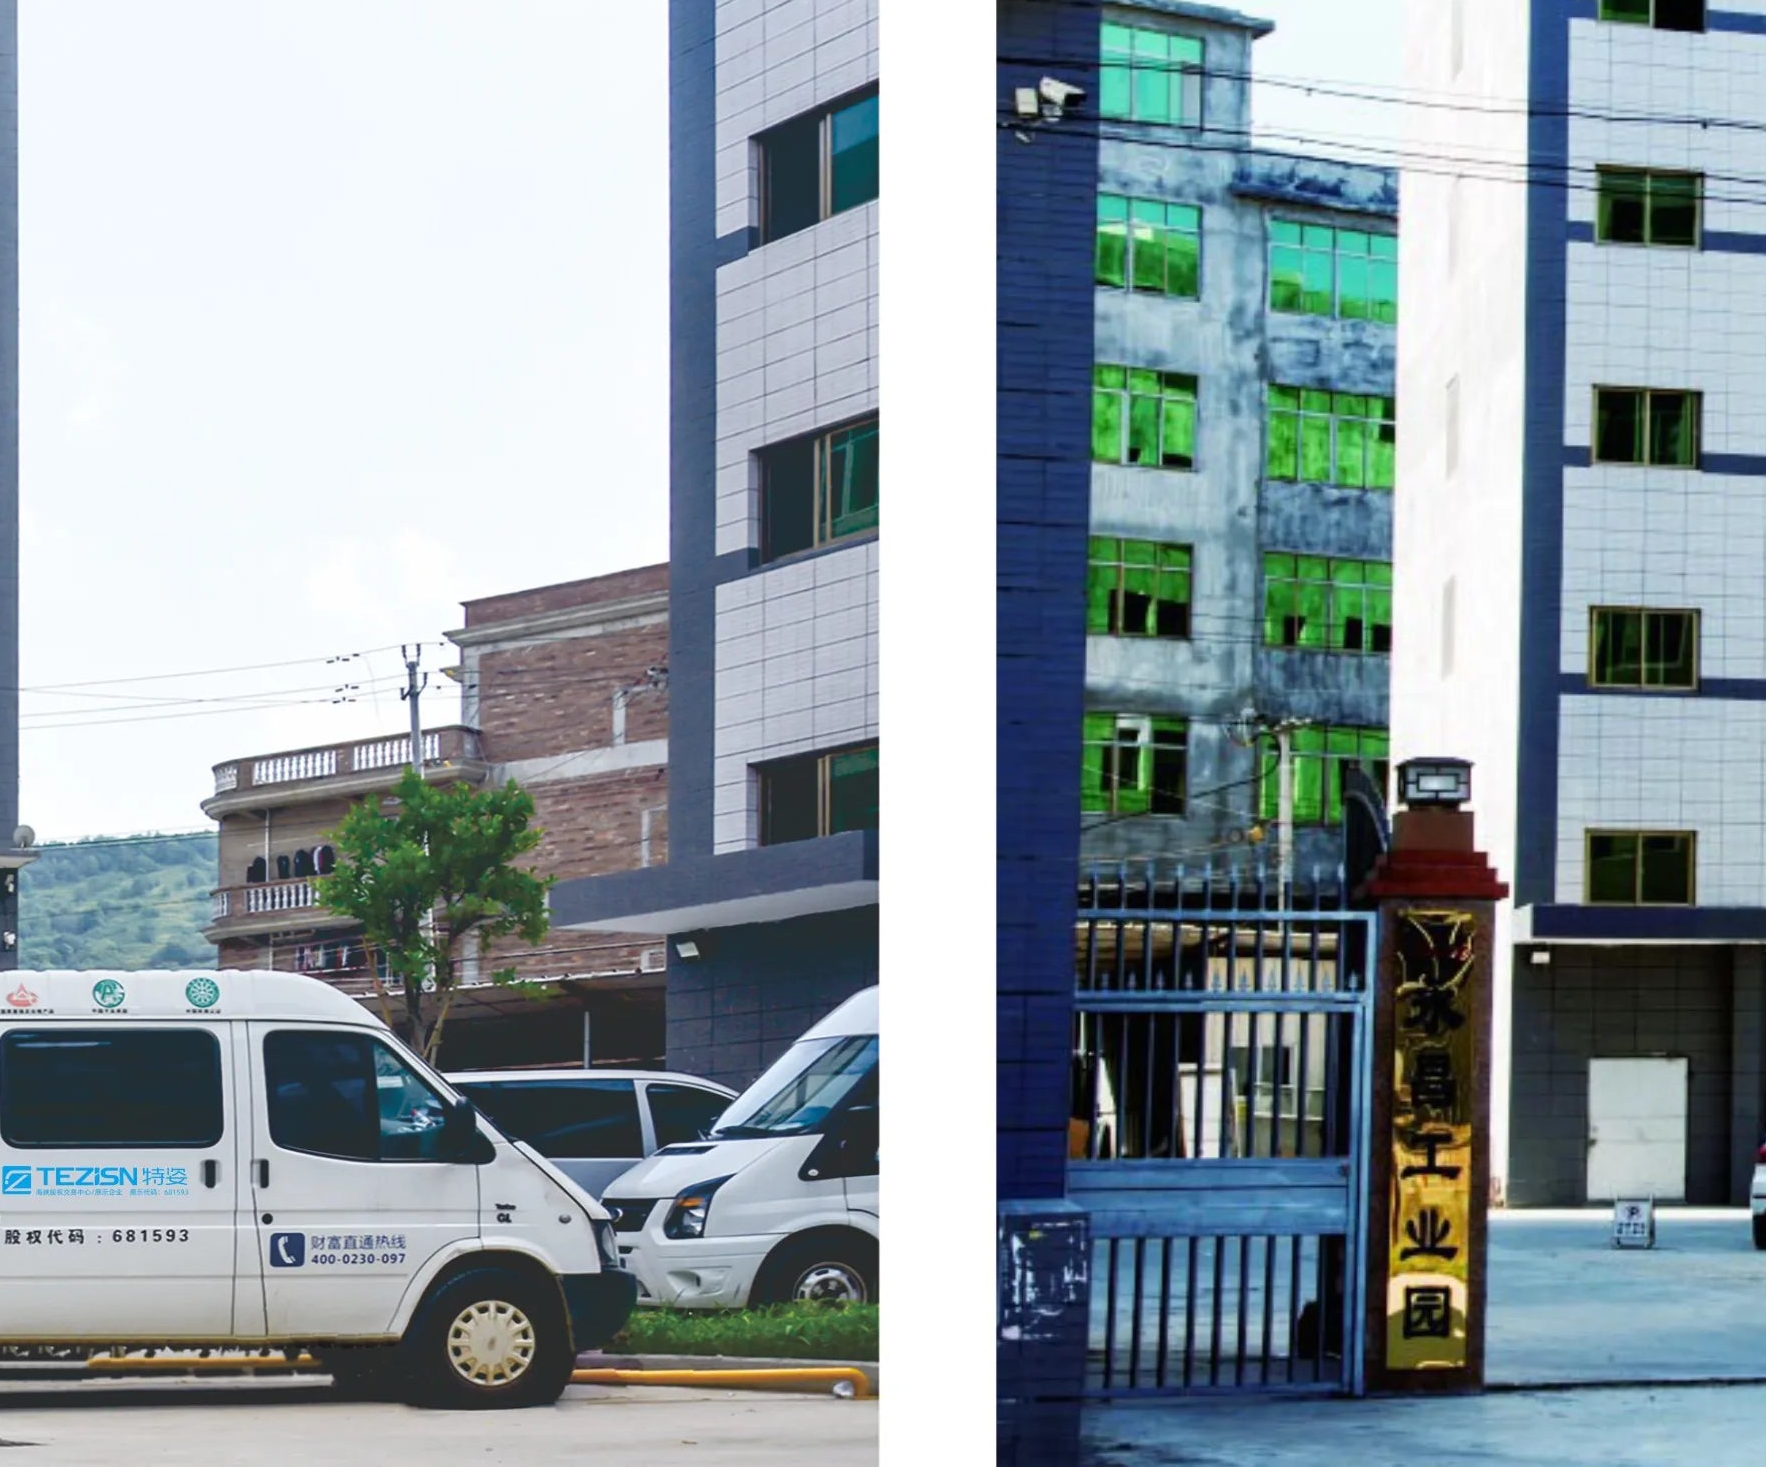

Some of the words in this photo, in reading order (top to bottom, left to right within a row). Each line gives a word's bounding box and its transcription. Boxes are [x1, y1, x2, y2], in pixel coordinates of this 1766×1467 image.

[1400, 987, 1465, 1339] 永昌工业园
[142, 1167, 188, 1186] 特姿
[310, 1234, 407, 1251] 财富直通热线
[310, 1252, 407, 1265] 400-0230-097
